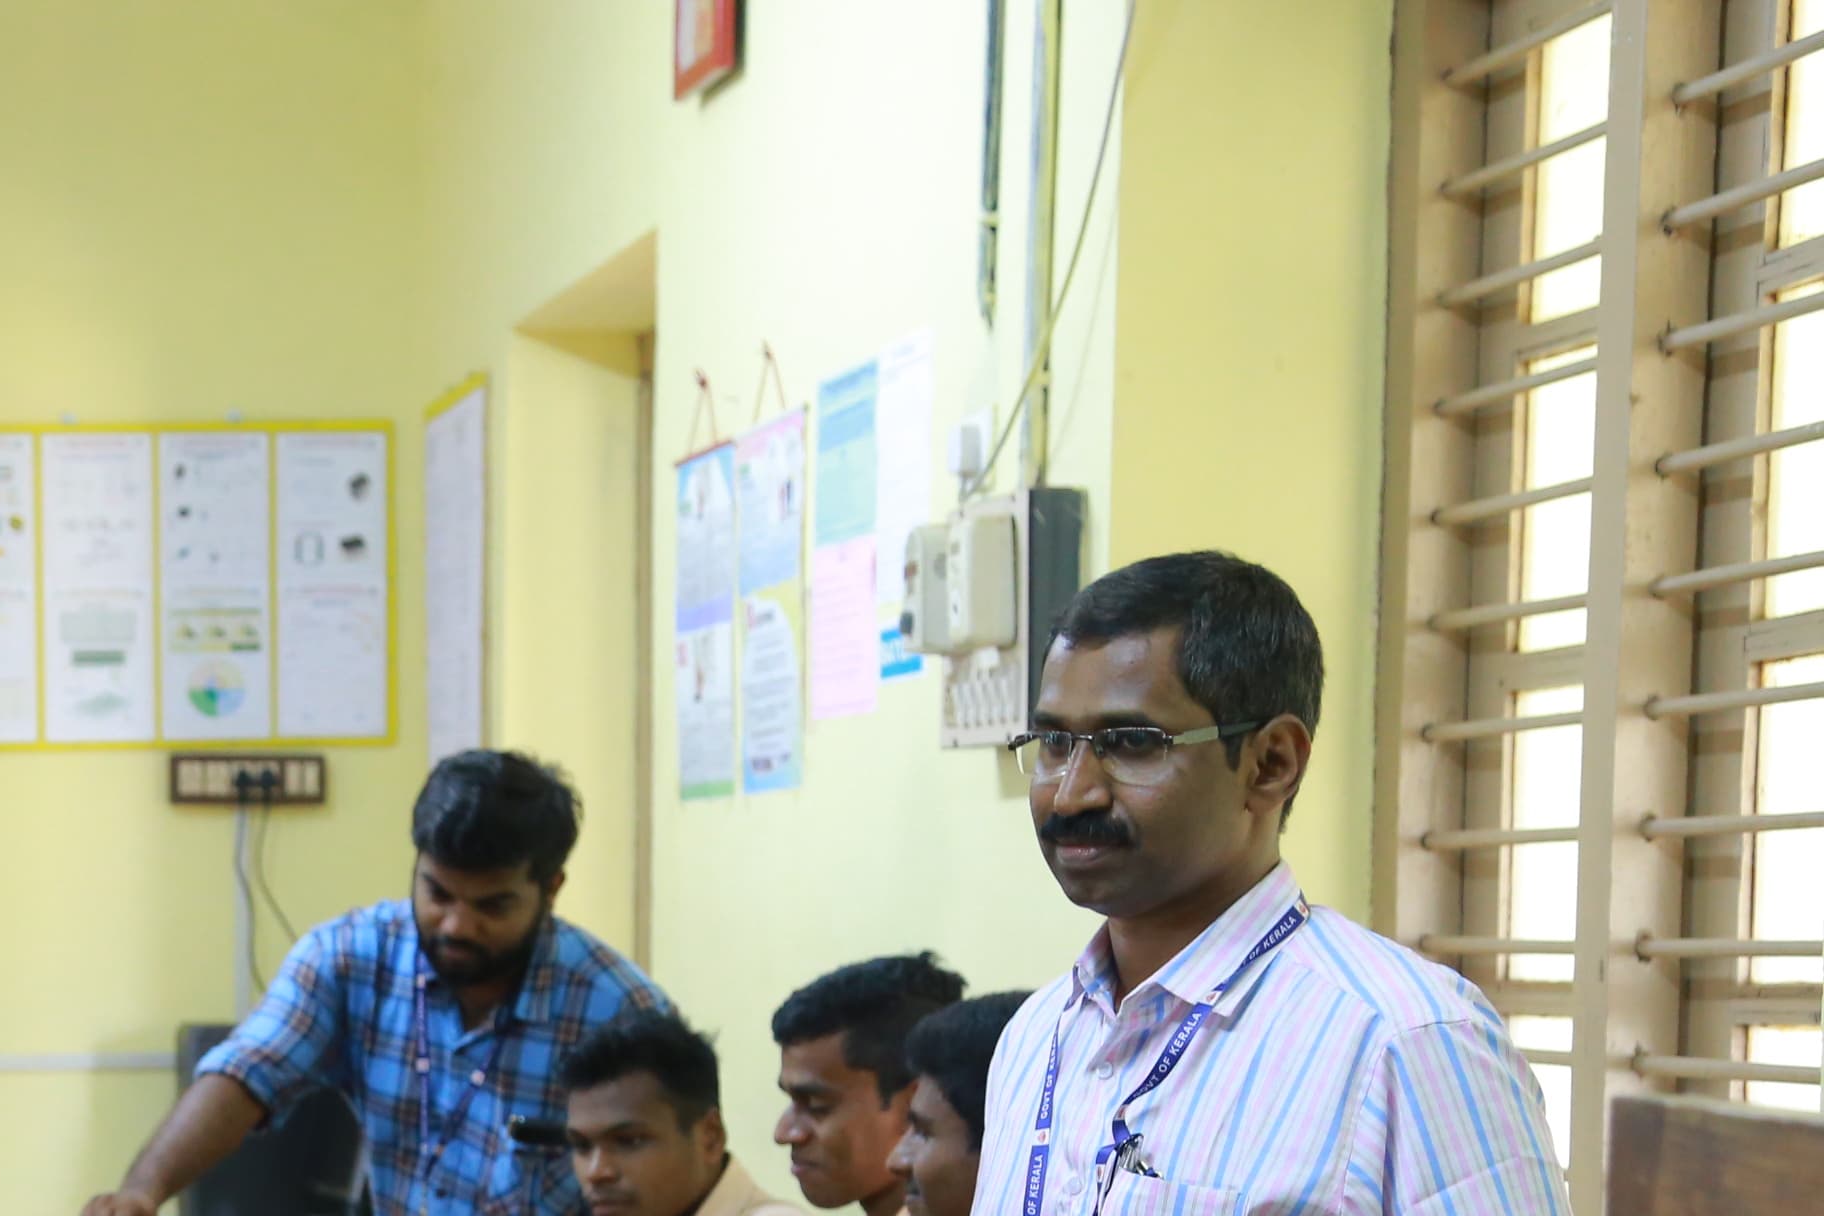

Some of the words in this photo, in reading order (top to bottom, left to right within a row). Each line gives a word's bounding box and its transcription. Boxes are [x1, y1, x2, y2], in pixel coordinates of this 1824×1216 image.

[1263, 916, 1297, 950] KERALA
[1158, 1055, 1172, 1073] OF
[1168, 1012, 1203, 1056] KERALA
[1040, 1091, 1052, 1120] GOVT
[1029, 1154, 1044, 1199] KERALA
[1026, 1200, 1037, 1216] OF
